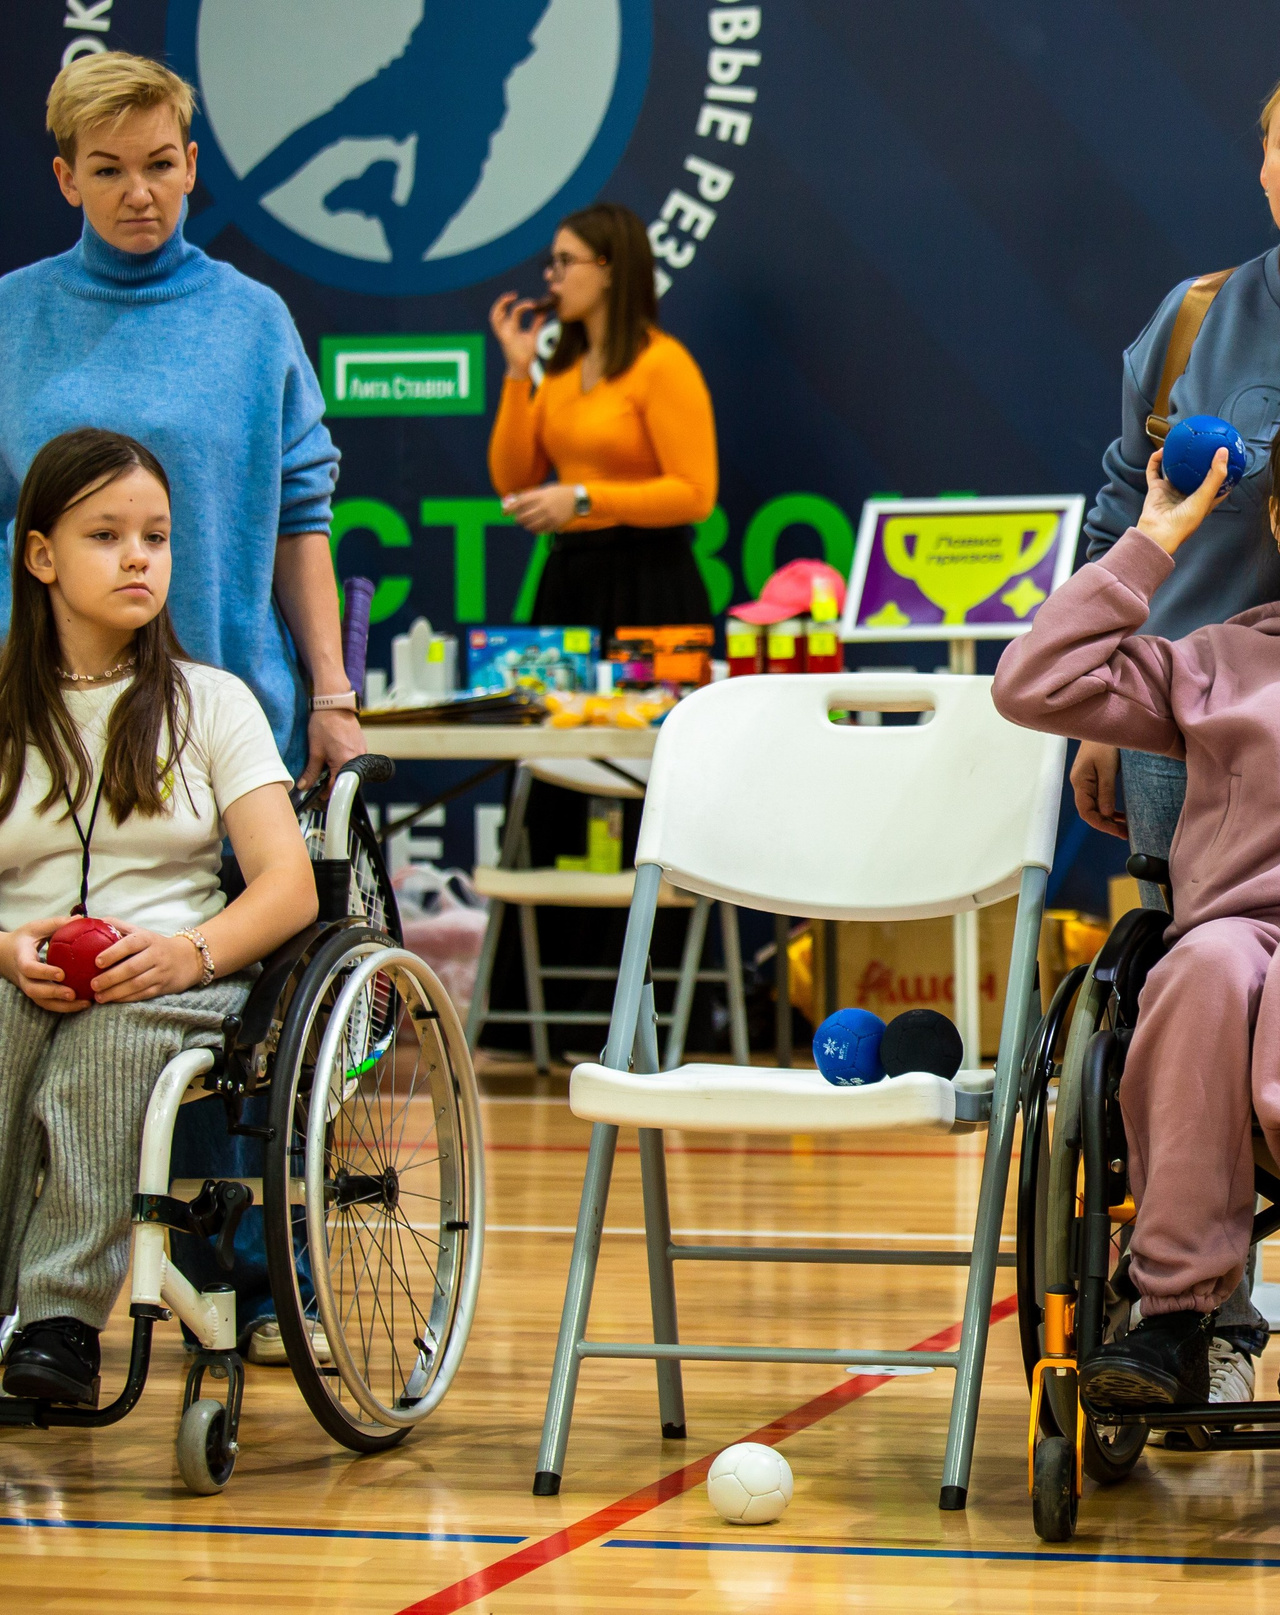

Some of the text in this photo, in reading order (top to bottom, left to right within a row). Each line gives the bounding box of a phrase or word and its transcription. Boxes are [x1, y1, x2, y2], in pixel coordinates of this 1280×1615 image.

[646, 0, 762, 298] ВЫЕ РЕЗ
[393, 375, 456, 400] Ставок
[332, 491, 979, 624] СТВО
